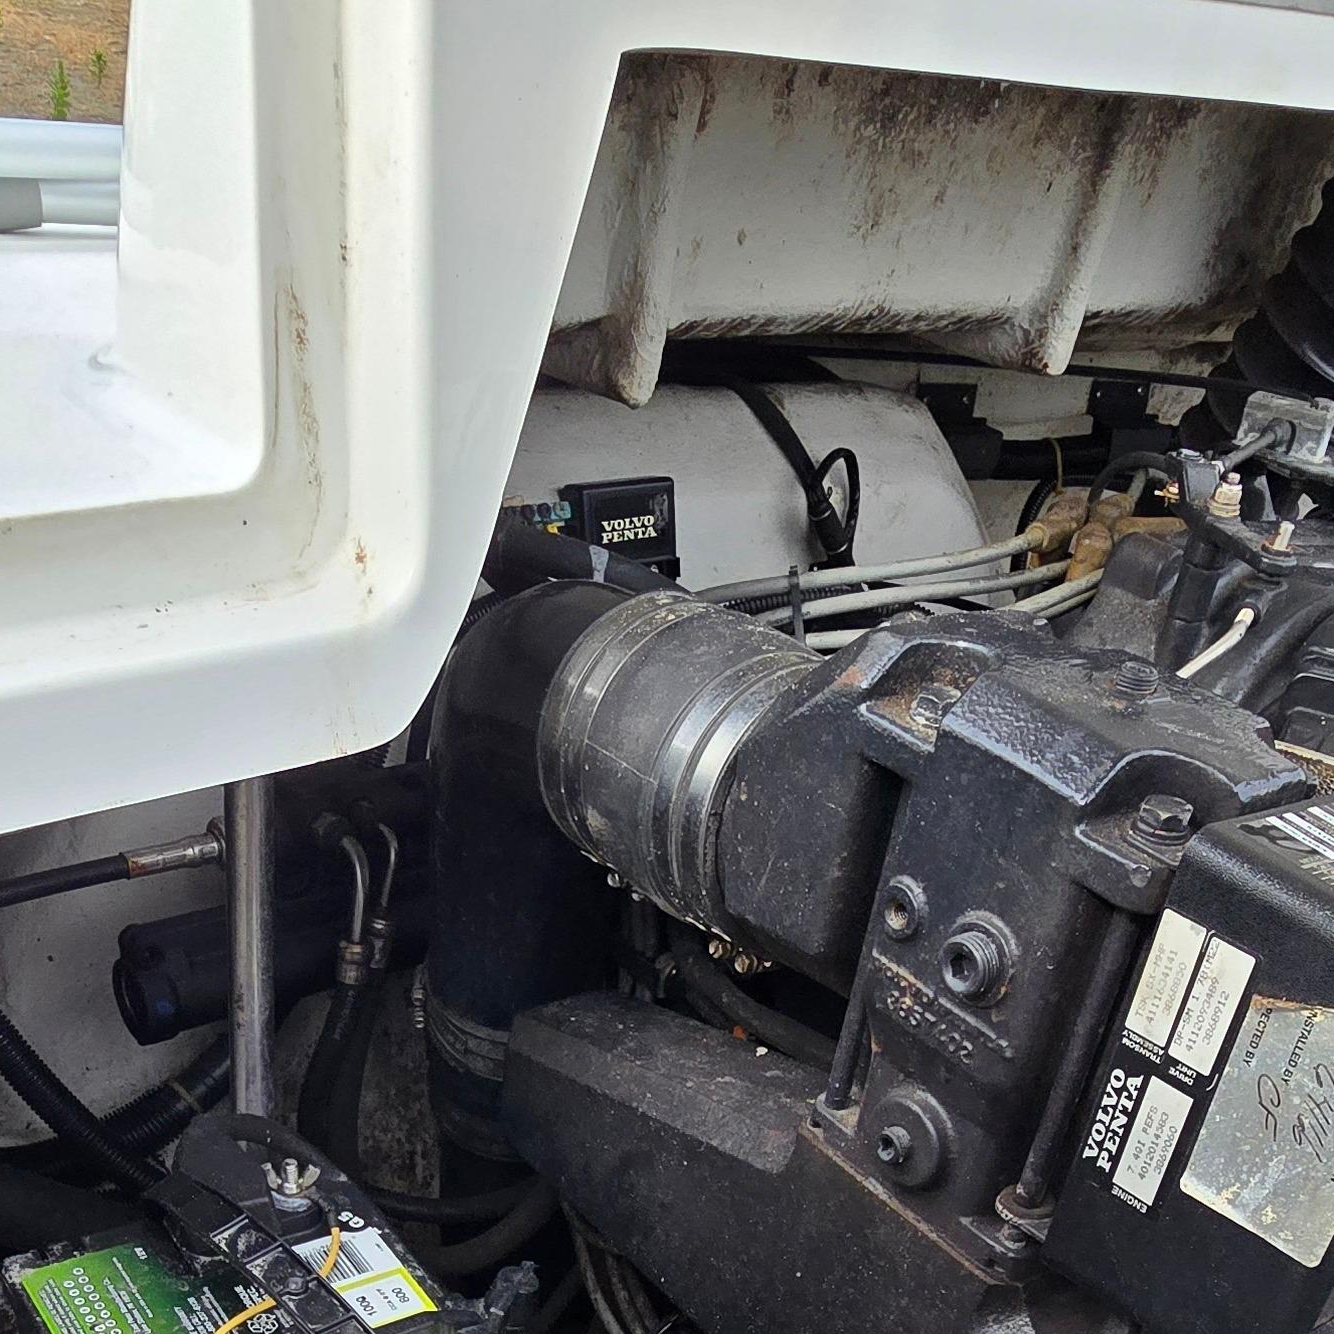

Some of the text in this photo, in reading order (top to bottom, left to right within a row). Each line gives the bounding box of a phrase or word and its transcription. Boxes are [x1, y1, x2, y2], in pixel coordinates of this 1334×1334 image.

[601, 515, 655, 531] VOLVO
[601, 526, 657, 544] PENTA
[1121, 1028, 1164, 1056] ASSEMBLY
[1121, 1037, 1162, 1064] TRANSOM
[1279, 1008, 1318, 1086] NSTALLED BY
[1175, 1062, 1197, 1078] UNIT
[1241, 1049, 1255, 1067] BY
[1167, 1066, 1193, 1085] DRIVE
[1081, 1066, 1128, 1163] VOLVO
[1095, 1069, 1144, 1172] PENTA
[1110, 1184, 1148, 1213] ENGINE
[335, 1208, 366, 1231] G5
